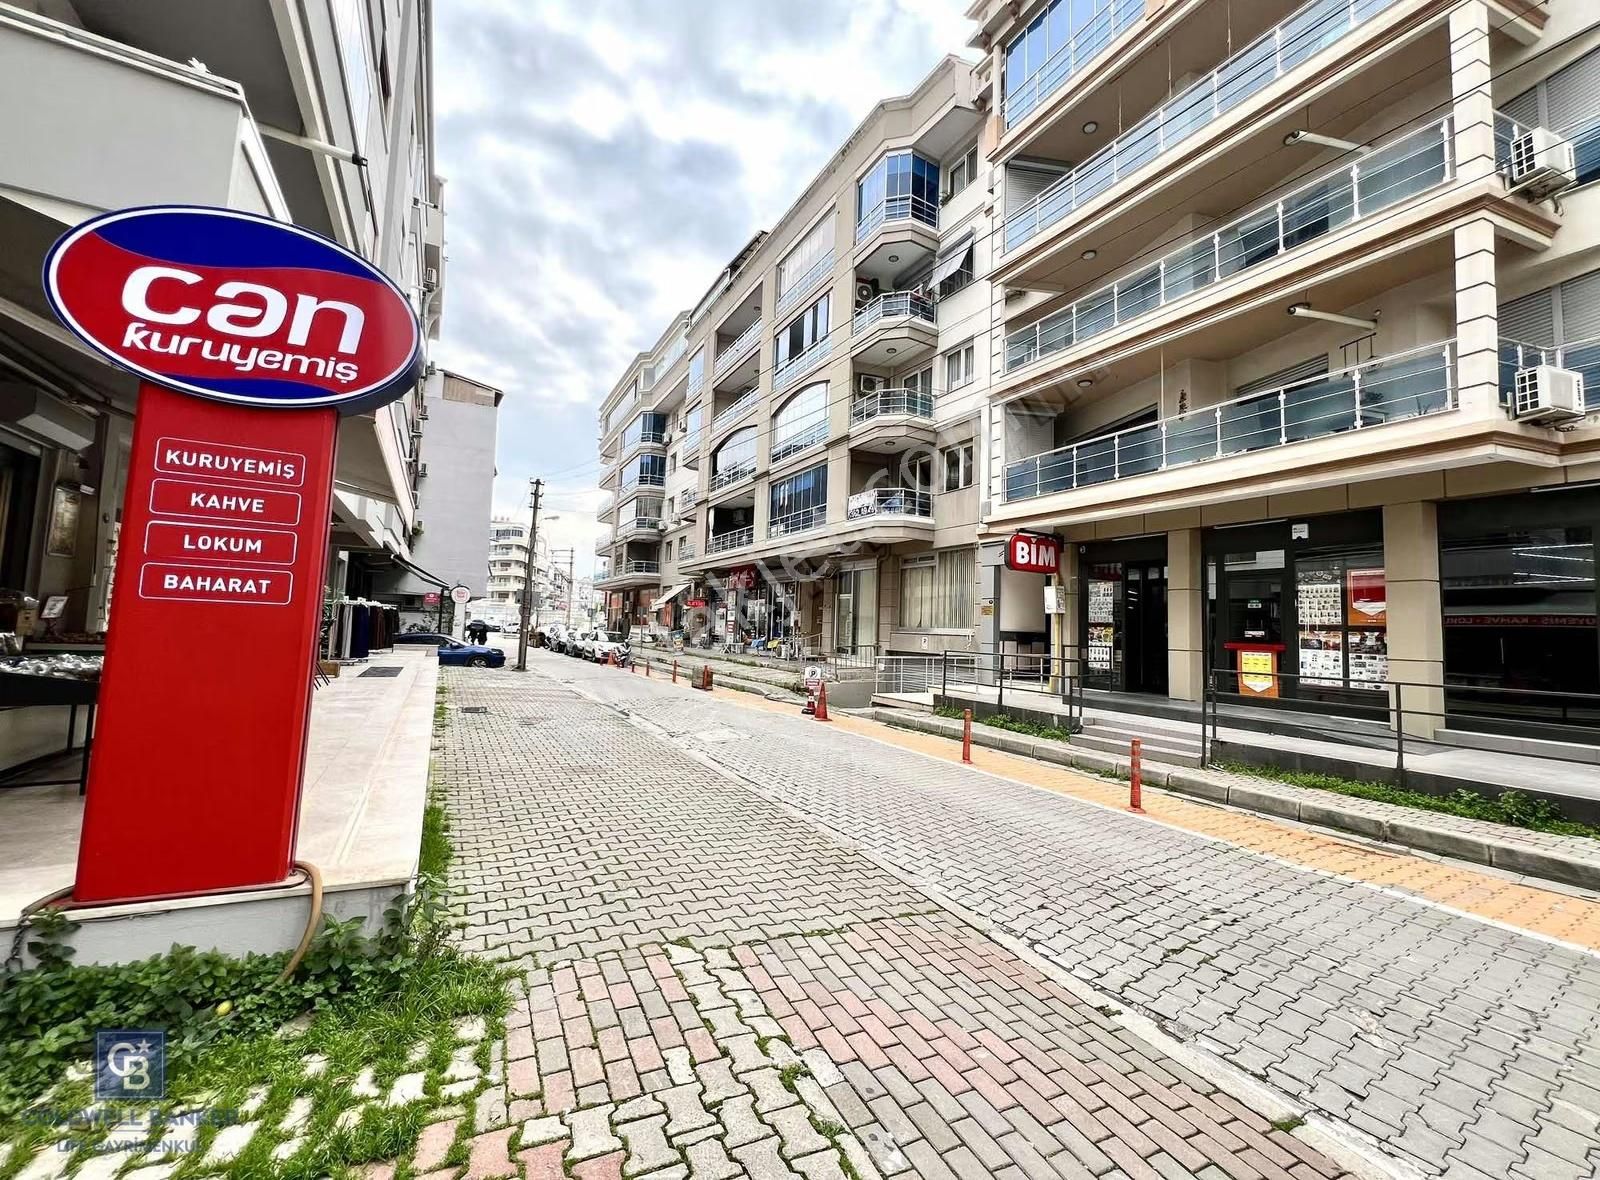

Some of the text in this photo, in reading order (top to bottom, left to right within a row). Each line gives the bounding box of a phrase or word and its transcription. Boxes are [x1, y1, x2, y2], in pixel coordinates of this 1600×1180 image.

[121, 266, 365, 355] can
[122, 322, 359, 383] kuruyemiş
[165, 449, 295, 479] KURUYEMİŞ
[190, 492, 265, 513] KAHVE
[183, 534, 262, 553] LOKUM
[1015, 538, 1056, 568] BİM
[163, 574, 271, 594] BAHARAT
